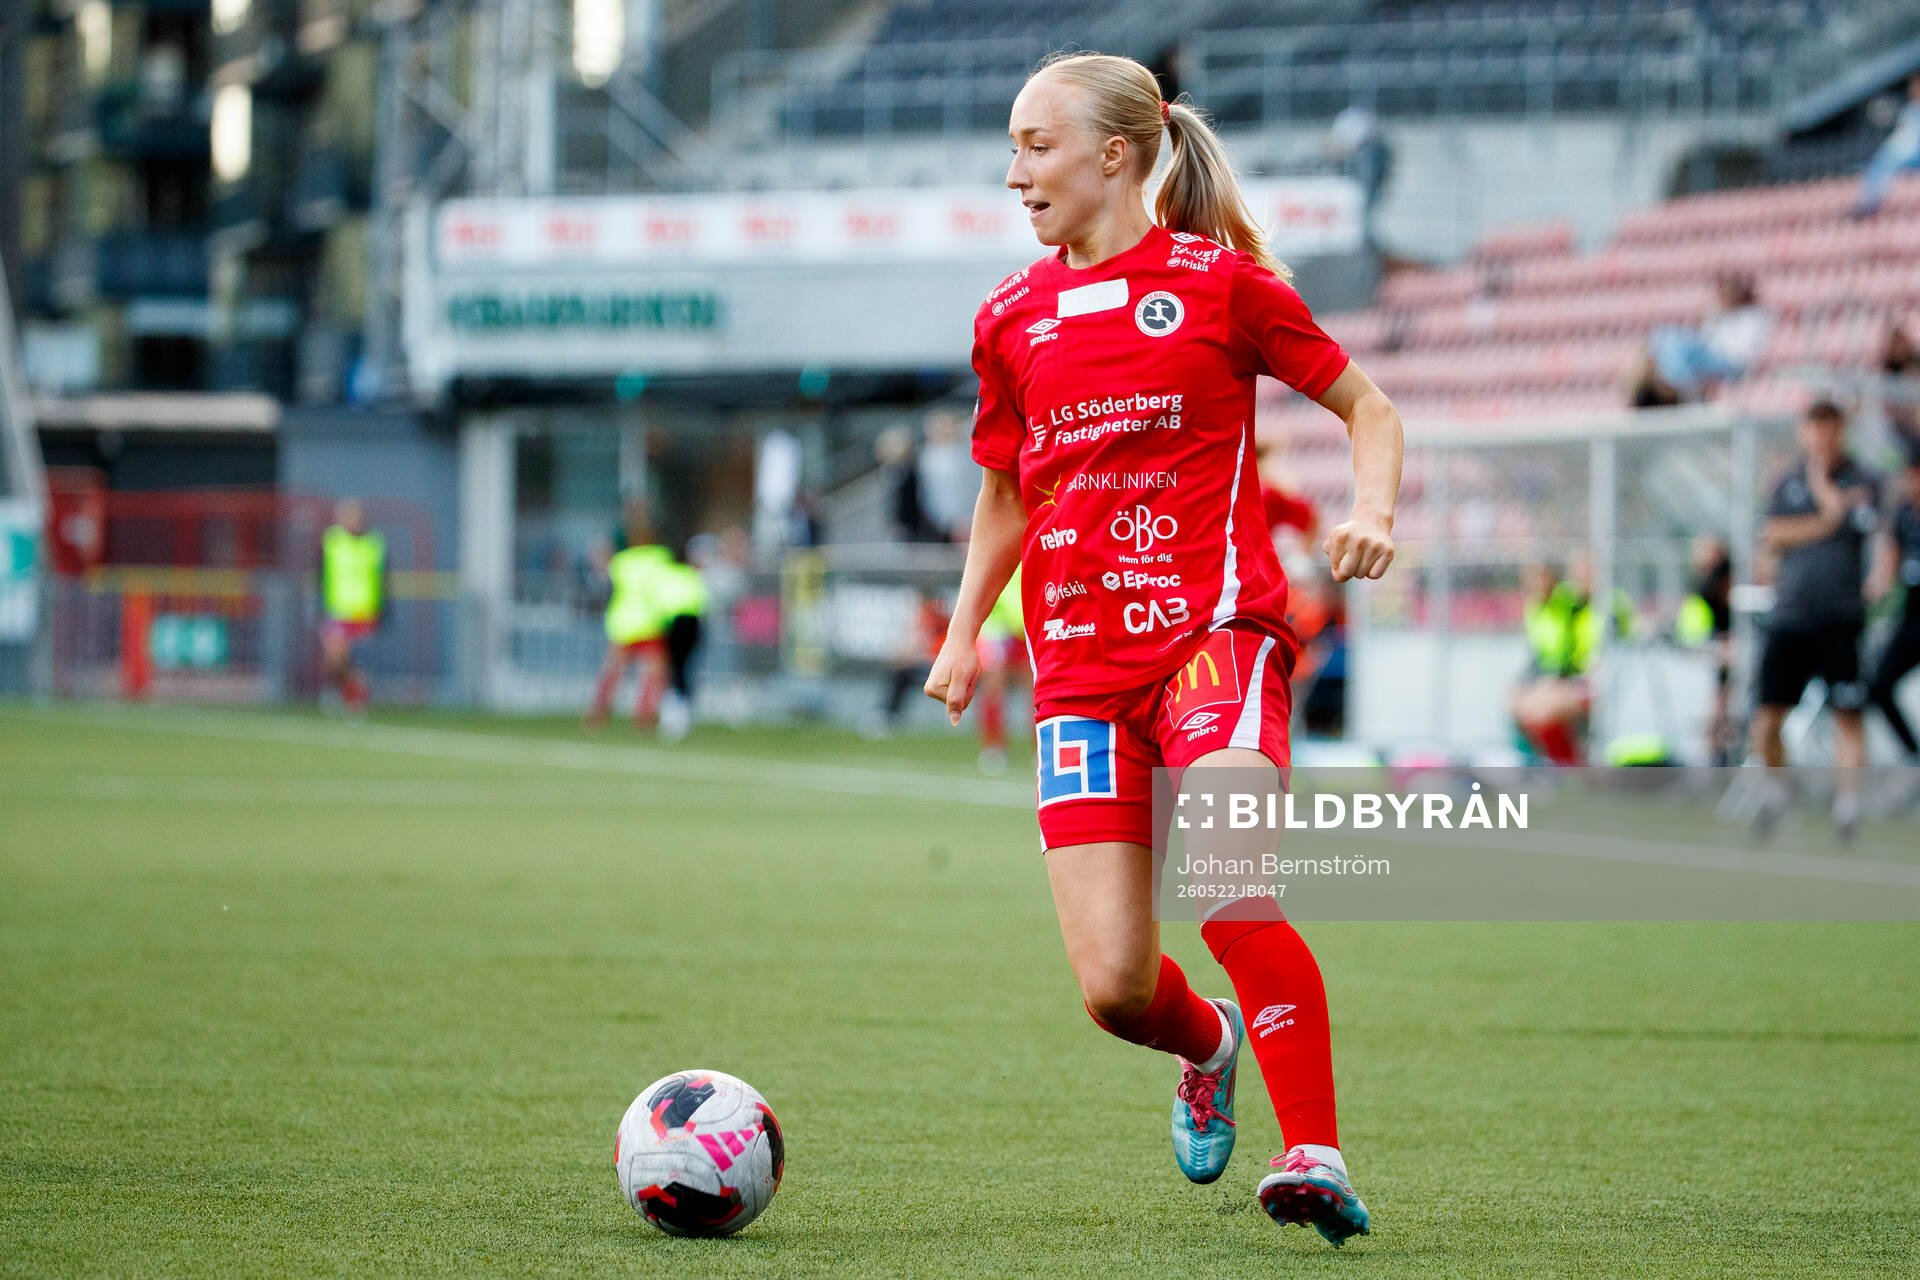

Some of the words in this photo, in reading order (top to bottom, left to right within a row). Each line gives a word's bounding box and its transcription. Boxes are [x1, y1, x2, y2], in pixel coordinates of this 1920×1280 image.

[1181, 258, 1209, 272] friskis
[1004, 286, 1030, 307] friskis
[1030, 332, 1059, 347] umbro
[1050, 405, 1074, 426] LG
[1077, 392, 1183, 420] Söderberg
[1054, 416, 1152, 446] Fastigheter
[1154, 414, 1182, 430] AB
[1066, 471, 1177, 493] ARNKLINIKEN
[1110, 504, 1178, 553] ÖBO
[1118, 554, 1139, 565] Hem
[1141, 554, 1154, 565] för
[1157, 553, 1173, 563] dig
[1123, 570, 1181, 590] Epiroc
[1187, 725, 1219, 742] umbro
[1260, 1018, 1295, 1038] umbro
